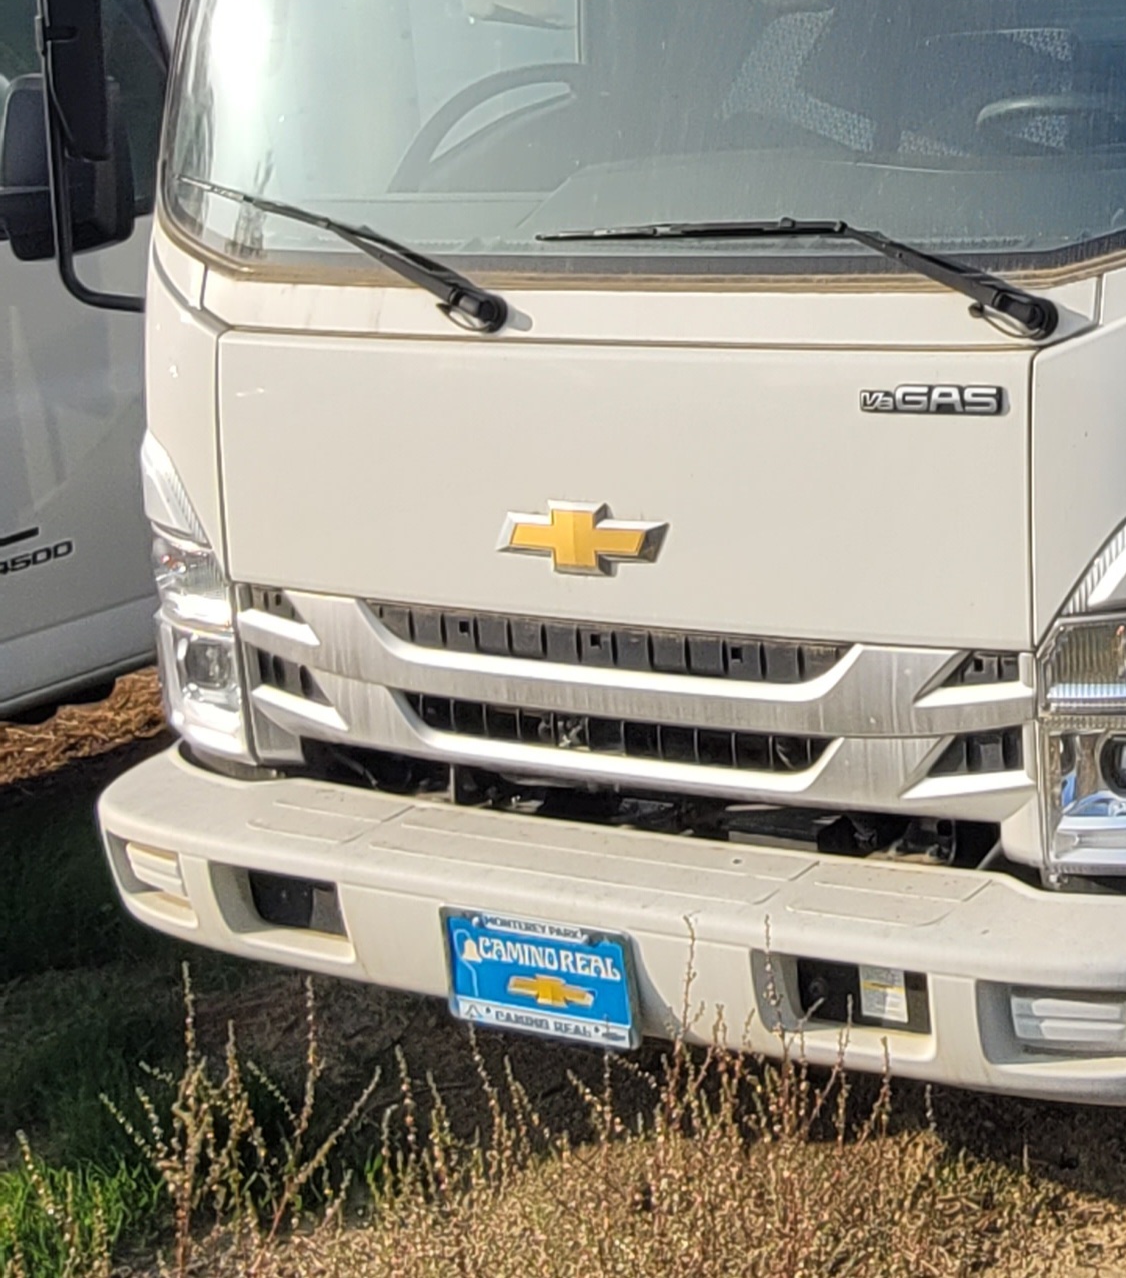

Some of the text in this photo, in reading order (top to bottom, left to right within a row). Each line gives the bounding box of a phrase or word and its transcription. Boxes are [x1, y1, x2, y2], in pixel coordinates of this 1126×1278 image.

[895, 385, 999, 414] GAS
[484, 915, 579, 940] MONTEREY PARK
[478, 936, 622, 982] CAMINO REAL
[495, 1009, 592, 1038] CAMINO REAL
